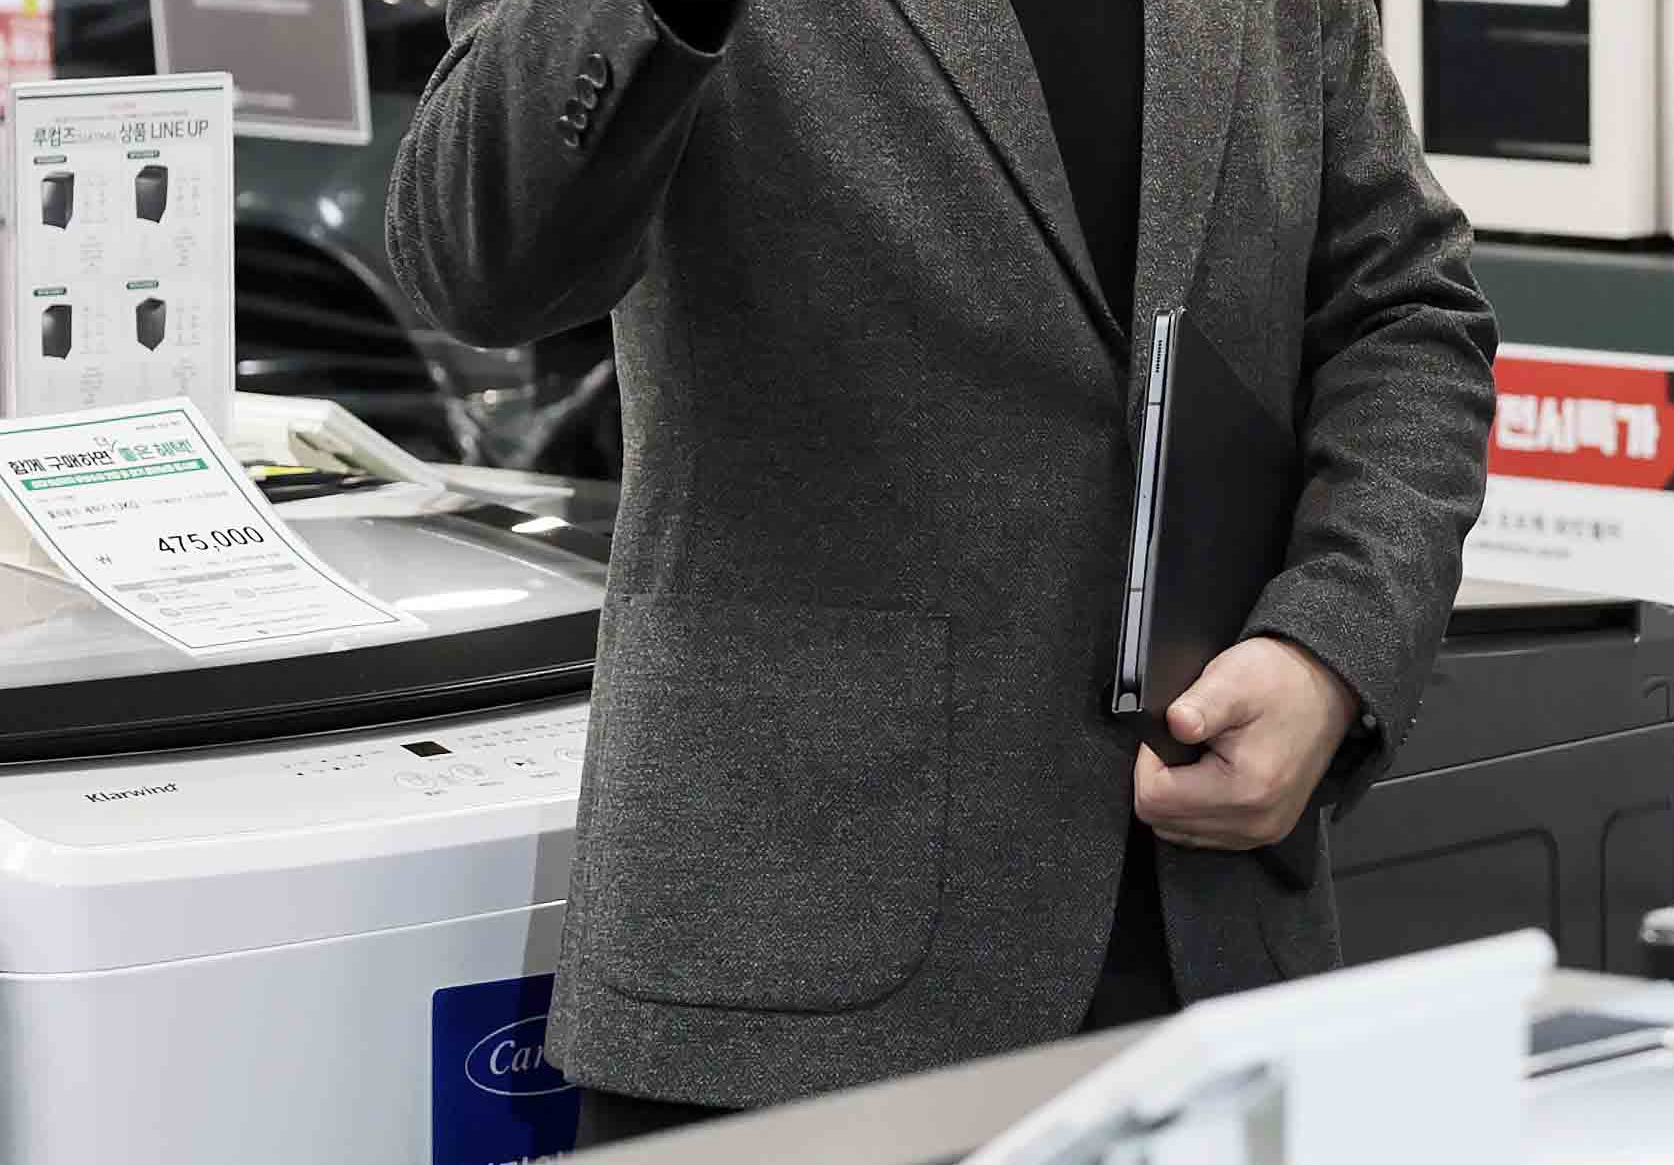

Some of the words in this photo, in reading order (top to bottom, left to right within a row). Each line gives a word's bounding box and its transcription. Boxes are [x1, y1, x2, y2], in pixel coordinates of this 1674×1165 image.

[151, 121, 185, 140] LINE
[187, 119, 209, 138] UP
[1495, 394, 1660, 461] 전시특가
[8, 456, 47, 475] 함께
[47, 450, 115, 472] 구매하면
[157, 526, 265, 554] 475,000
[85, 781, 178, 804] Klarwind
